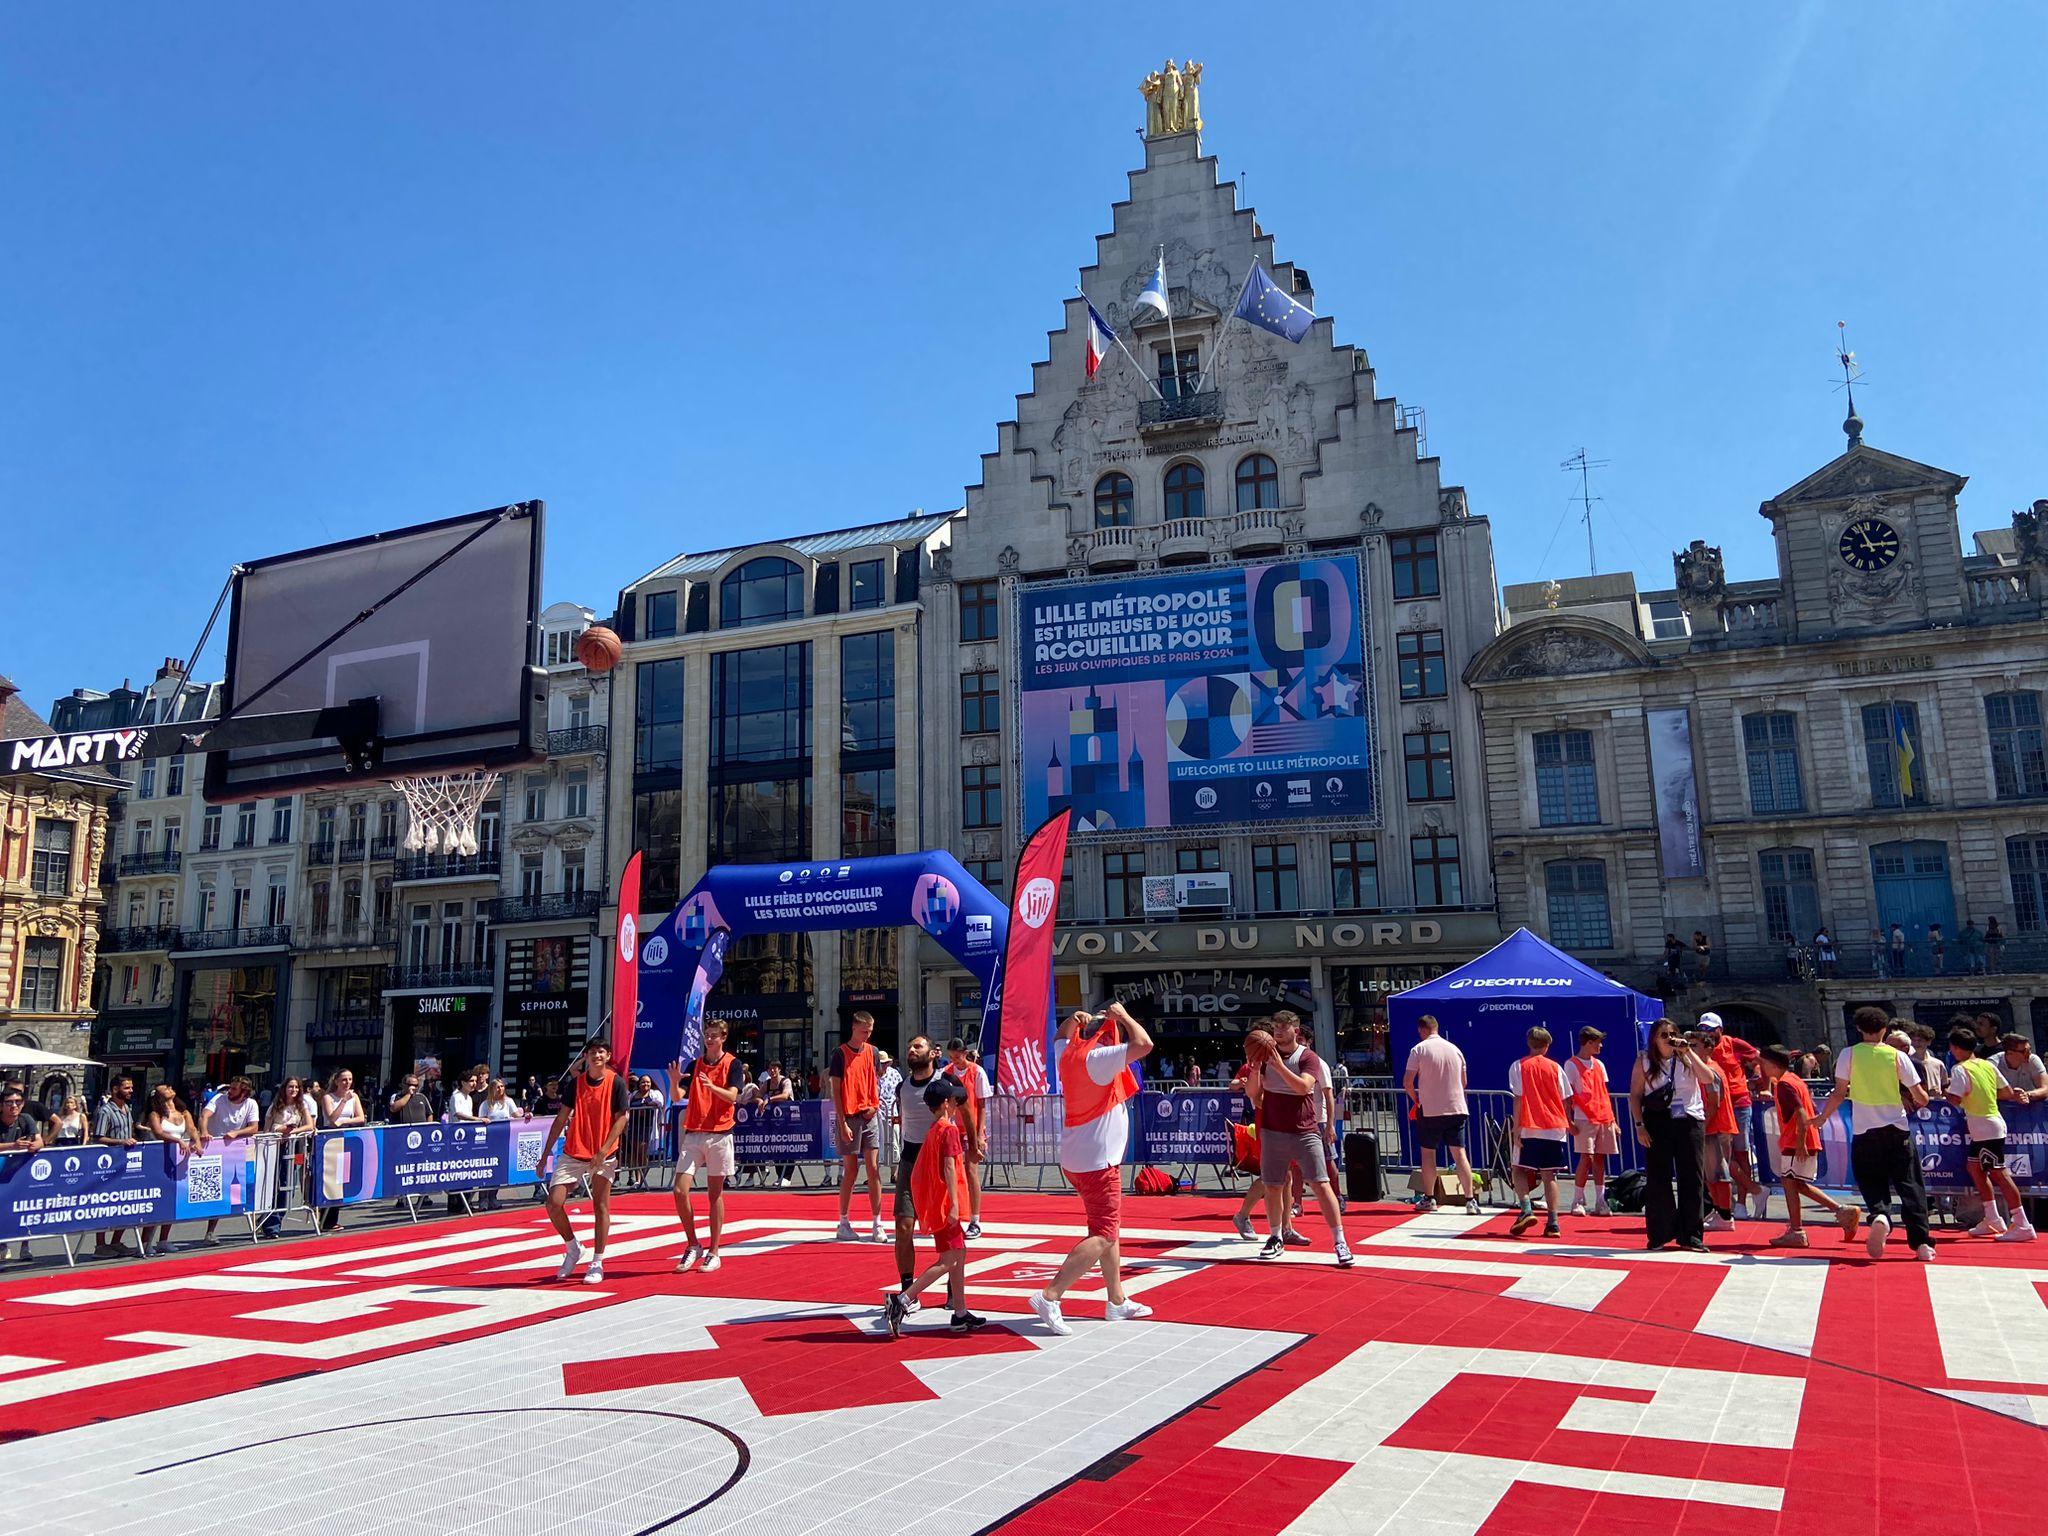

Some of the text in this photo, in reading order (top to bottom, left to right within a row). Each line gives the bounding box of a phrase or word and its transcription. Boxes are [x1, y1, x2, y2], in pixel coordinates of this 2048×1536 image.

[1035, 588, 1231, 625] LILLE MÉTROPOLE
[1034, 610, 1232, 642] EST HEUREUSE DE VOUS
[1035, 627, 1233, 662] ACCUEILLIR POUR
[1035, 649, 1234, 675] LES JEUX OLYMPIQUES DE PARIS 2024
[11, 730, 137, 770] MARTY
[1177, 755, 1360, 777] WELCOME TO LILLE MÉTROPOLE
[1288, 786, 1311, 796] MEL
[745, 886, 883, 908] LILLE FIÈRE D'ACCUEILLIR
[753, 901, 878, 920] LES JEUX OLYMPIQUES
[966, 922, 992, 933] MEL
[1053, 919, 1442, 955] VOIX DU NORD
[1113, 970, 1289, 1003] GRAND' PLACE
[1359, 980, 1378, 992] LE
[1473, 978, 1573, 987] DECATHLON
[520, 1000, 569, 1012] SEPHORA
[1162, 989, 1241, 1013] fnac
[1489, 1003, 1534, 1011] DECATHLON
[705, 1008, 758, 1020] SEPHORA
[733, 1132, 813, 1143] LLE FIÈRE D'ACCUEILLIR
[1145, 1132, 1169, 1141] LILLE
[1169, 1129, 1195, 1141] FIÈRE
[1916, 1131, 1926, 1146] À
[1929, 1133, 1963, 1146] NOS
[745, 1145, 761, 1154] JEUX
[761, 1144, 809, 1154] OLYMPIQUES
[1151, 1144, 1168, 1153] LES
[1169, 1144, 1192, 1153] JEUX
[416, 1160, 441, 1173] FIÈRE
[442, 1157, 499, 1170] D'ACCUEILLIR
[415, 1173, 437, 1184] JEUX
[439, 1169, 493, 1182] OLYMPIQUES
[1922, 1171, 1954, 1179] CATHLON
[13, 1187, 162, 1213] LILLE FIÈRE D'ACCUEILLIR
[19, 1202, 154, 1227] LES JEUX OLYMPIQUES
